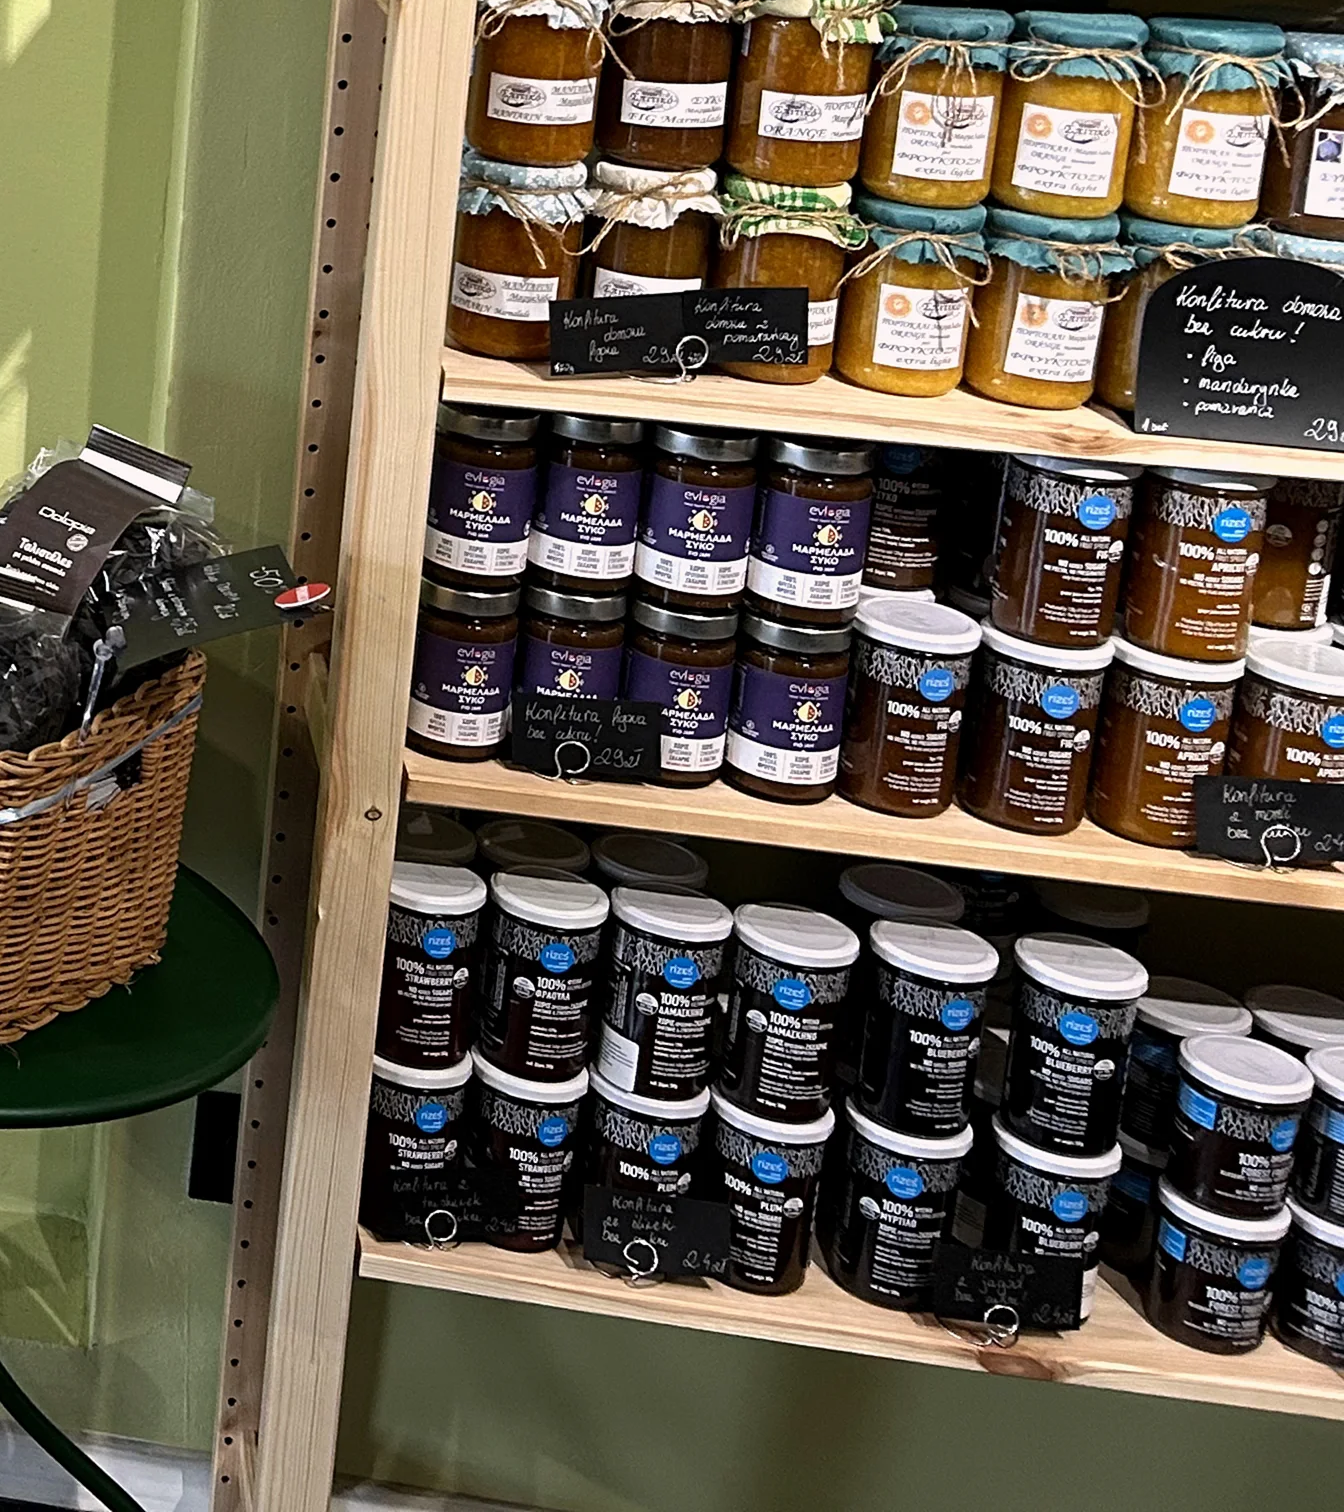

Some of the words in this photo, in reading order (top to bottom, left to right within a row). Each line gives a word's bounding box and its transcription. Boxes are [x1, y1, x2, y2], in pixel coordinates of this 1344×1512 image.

[627, 112, 657, 125] FIG
[764, 123, 827, 138] ORANGE
[914, 165, 943, 176] extra
[943, 165, 976, 181] light
[1034, 179, 1067, 192] extra
[1069, 181, 1098, 196] light
[1175, 284, 1270, 315] Konfitura
[694, 295, 764, 323] Konfitura
[563, 309, 620, 335] Konfitura
[1184, 316, 1214, 337] bez
[895, 356, 925, 366] extra
[926, 355, 953, 370] light
[1200, 344, 1238, 374] figa
[1028, 365, 1059, 377] extra
[1060, 366, 1086, 380] light
[1198, 376, 1301, 408] mandarynka
[38, 505, 97, 536] Dolopia
[449, 507, 511, 525] ΜΑΡΜΕΛΑΔΑ
[561, 511, 623, 527] ΜΑΡΜΕΛΑΔΑ
[465, 520, 494, 532] ΣΥΚΟ
[577, 524, 606, 536] ΣΥΚΟ
[668, 527, 732, 544] ΜΑΡΜΕΛΑΔΑ
[1044, 527, 1079, 549] 100%
[685, 540, 715, 551] ΣΥΚΟ
[792, 543, 855, 557] ΜΑΡΜΕΛΑΔΑ
[1178, 540, 1214, 562] 100%
[809, 554, 839, 566] ΣΥΚΟ
[441, 683, 500, 696] ΜΑΡΜΕΛΑΔΑ
[458, 694, 486, 705] ΣΥΚΟ
[525, 701, 602, 726] Konfitura
[886, 700, 920, 719] 100%
[772, 720, 834, 734] ΜΑΡΜΕΛΑΔΑ
[1008, 715, 1042, 736] 100%
[789, 731, 819, 742] ΣΥΚΟ
[1145, 729, 1180, 751] 100%
[1285, 746, 1321, 767] 100%
[395, 956, 425, 975] 100%
[404, 973, 453, 987] STRAWBERRY
[1045, 1057, 1093, 1075] BLUEBERRY
[398, 1149, 444, 1161] STRAWBERRY
[760, 1201, 784, 1214] PLUM
[1038, 1235, 1083, 1251] BLUEBERRY
